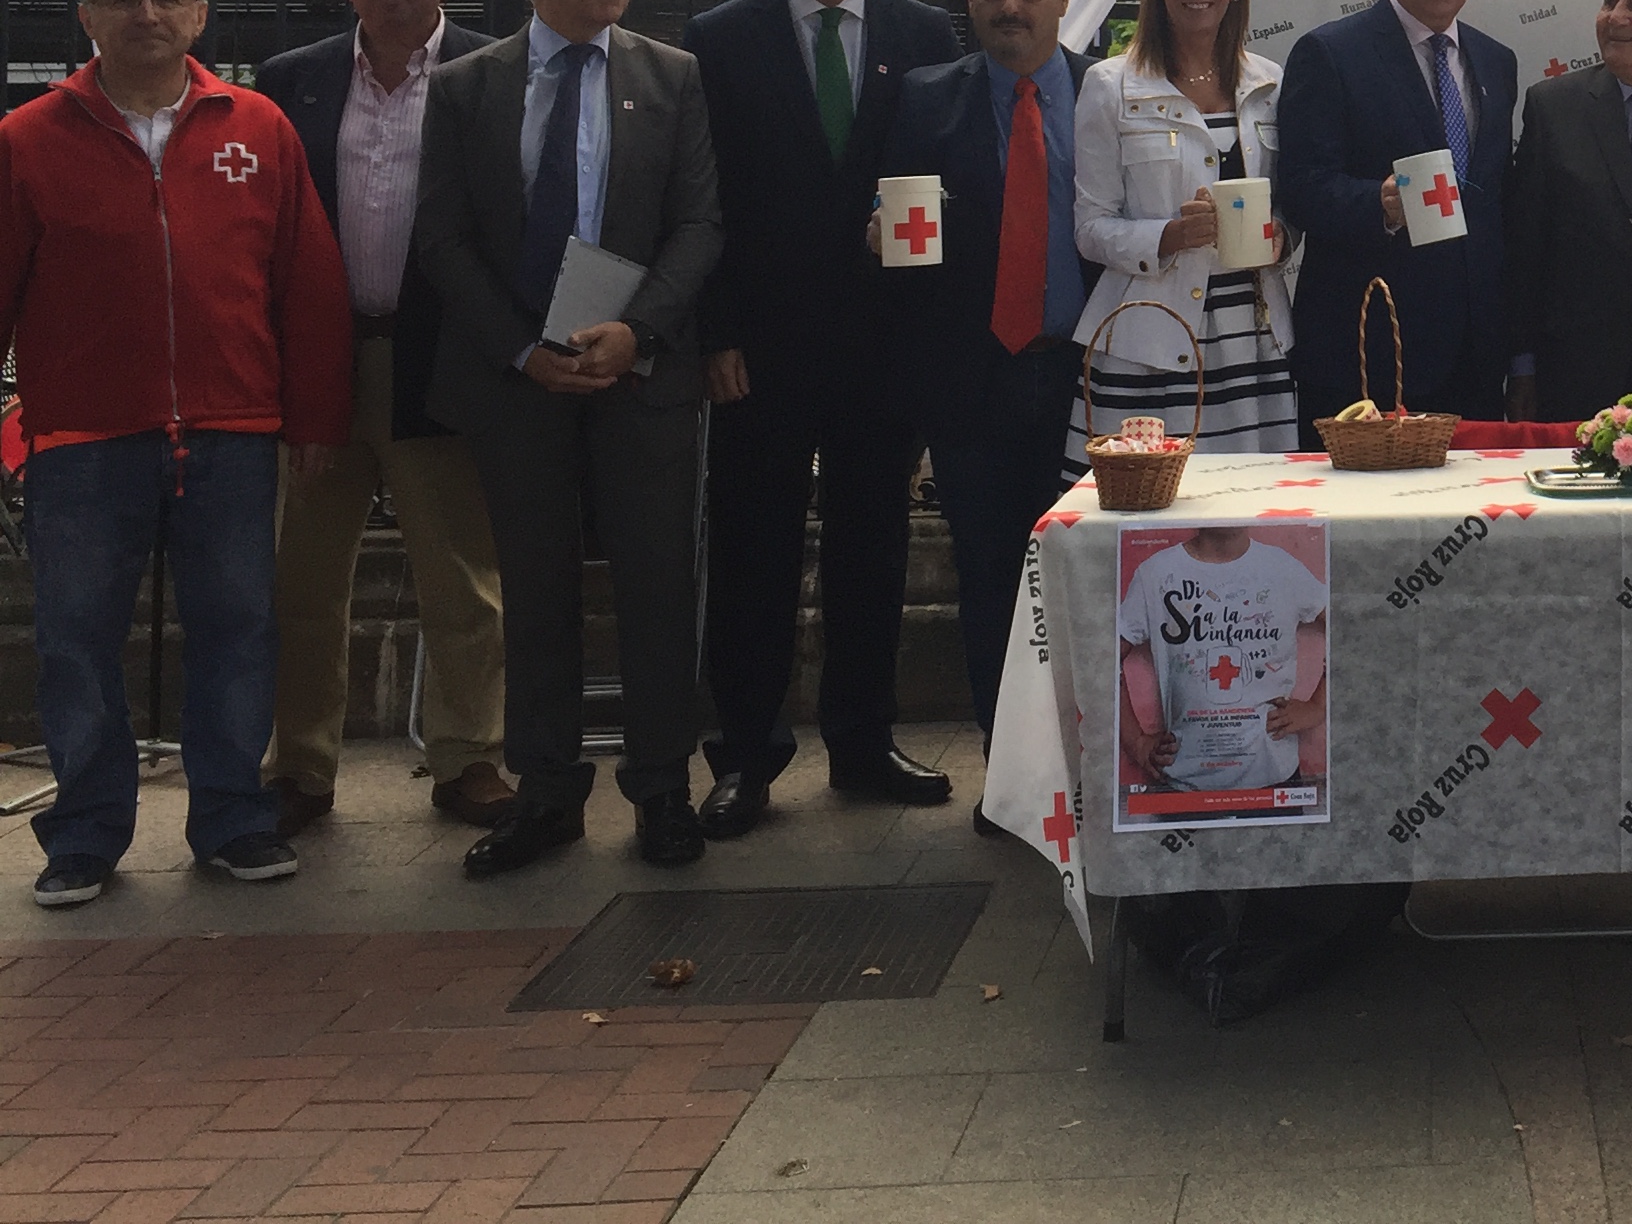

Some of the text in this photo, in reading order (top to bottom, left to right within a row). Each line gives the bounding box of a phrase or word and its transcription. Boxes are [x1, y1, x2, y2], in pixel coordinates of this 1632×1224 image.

[1519, 5, 1557, 25] Unidad
[1252, 20, 1294, 40] Española
[1570, 56, 1593, 69] Cruz
[1386, 515, 1488, 609] Cruz Roja
[1182, 579, 1204, 600] Di
[1161, 590, 1241, 645] Sí a la
[1209, 624, 1282, 646] infancia
[1387, 744, 1490, 843] Cruz Roja
